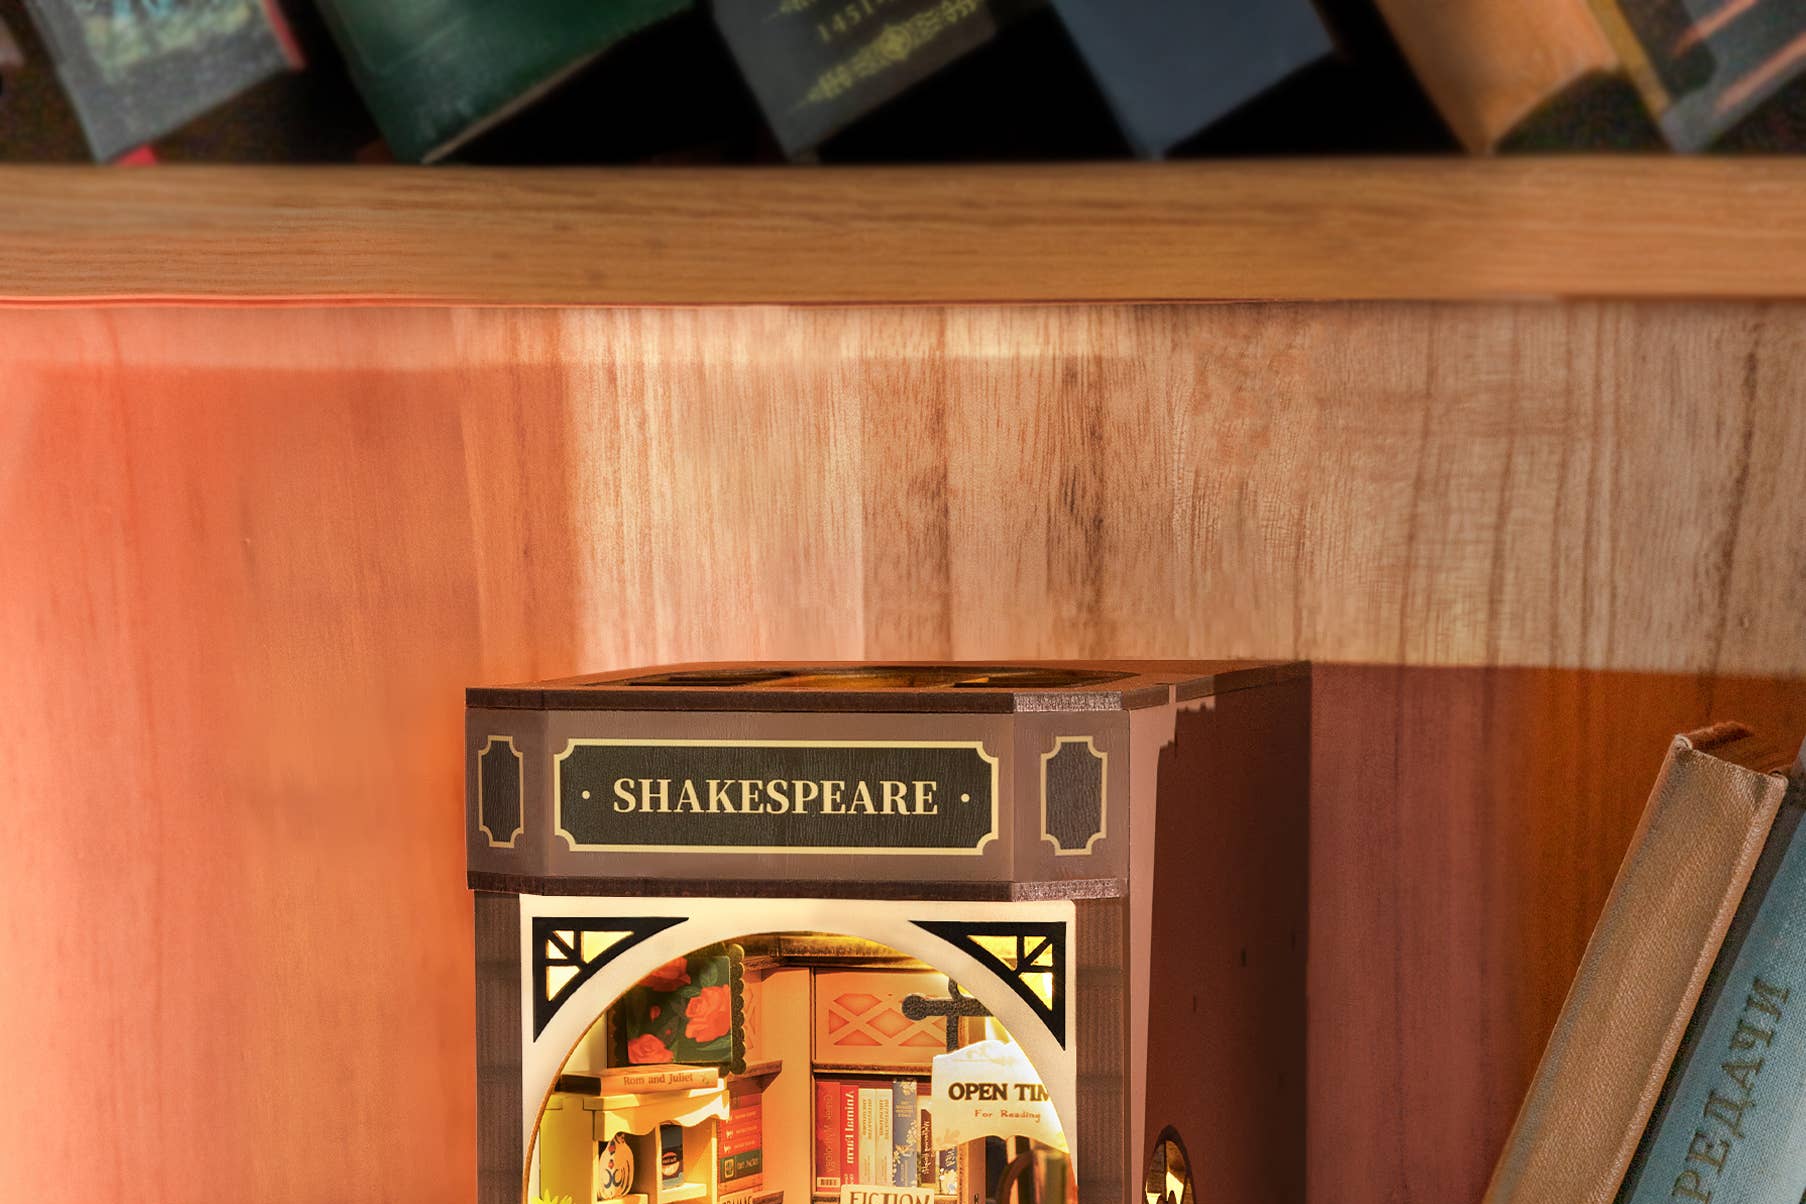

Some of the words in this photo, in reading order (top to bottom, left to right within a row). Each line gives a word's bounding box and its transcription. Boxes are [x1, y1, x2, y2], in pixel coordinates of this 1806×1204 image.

[613, 777, 938, 815] SHAKESPEARE
[648, 1074, 665, 1084] and
[668, 1073, 693, 1084] Juliet
[948, 1082, 1008, 1101] OPEN
[974, 1110, 992, 1118] For
[1001, 1110, 1041, 1123] Reading
